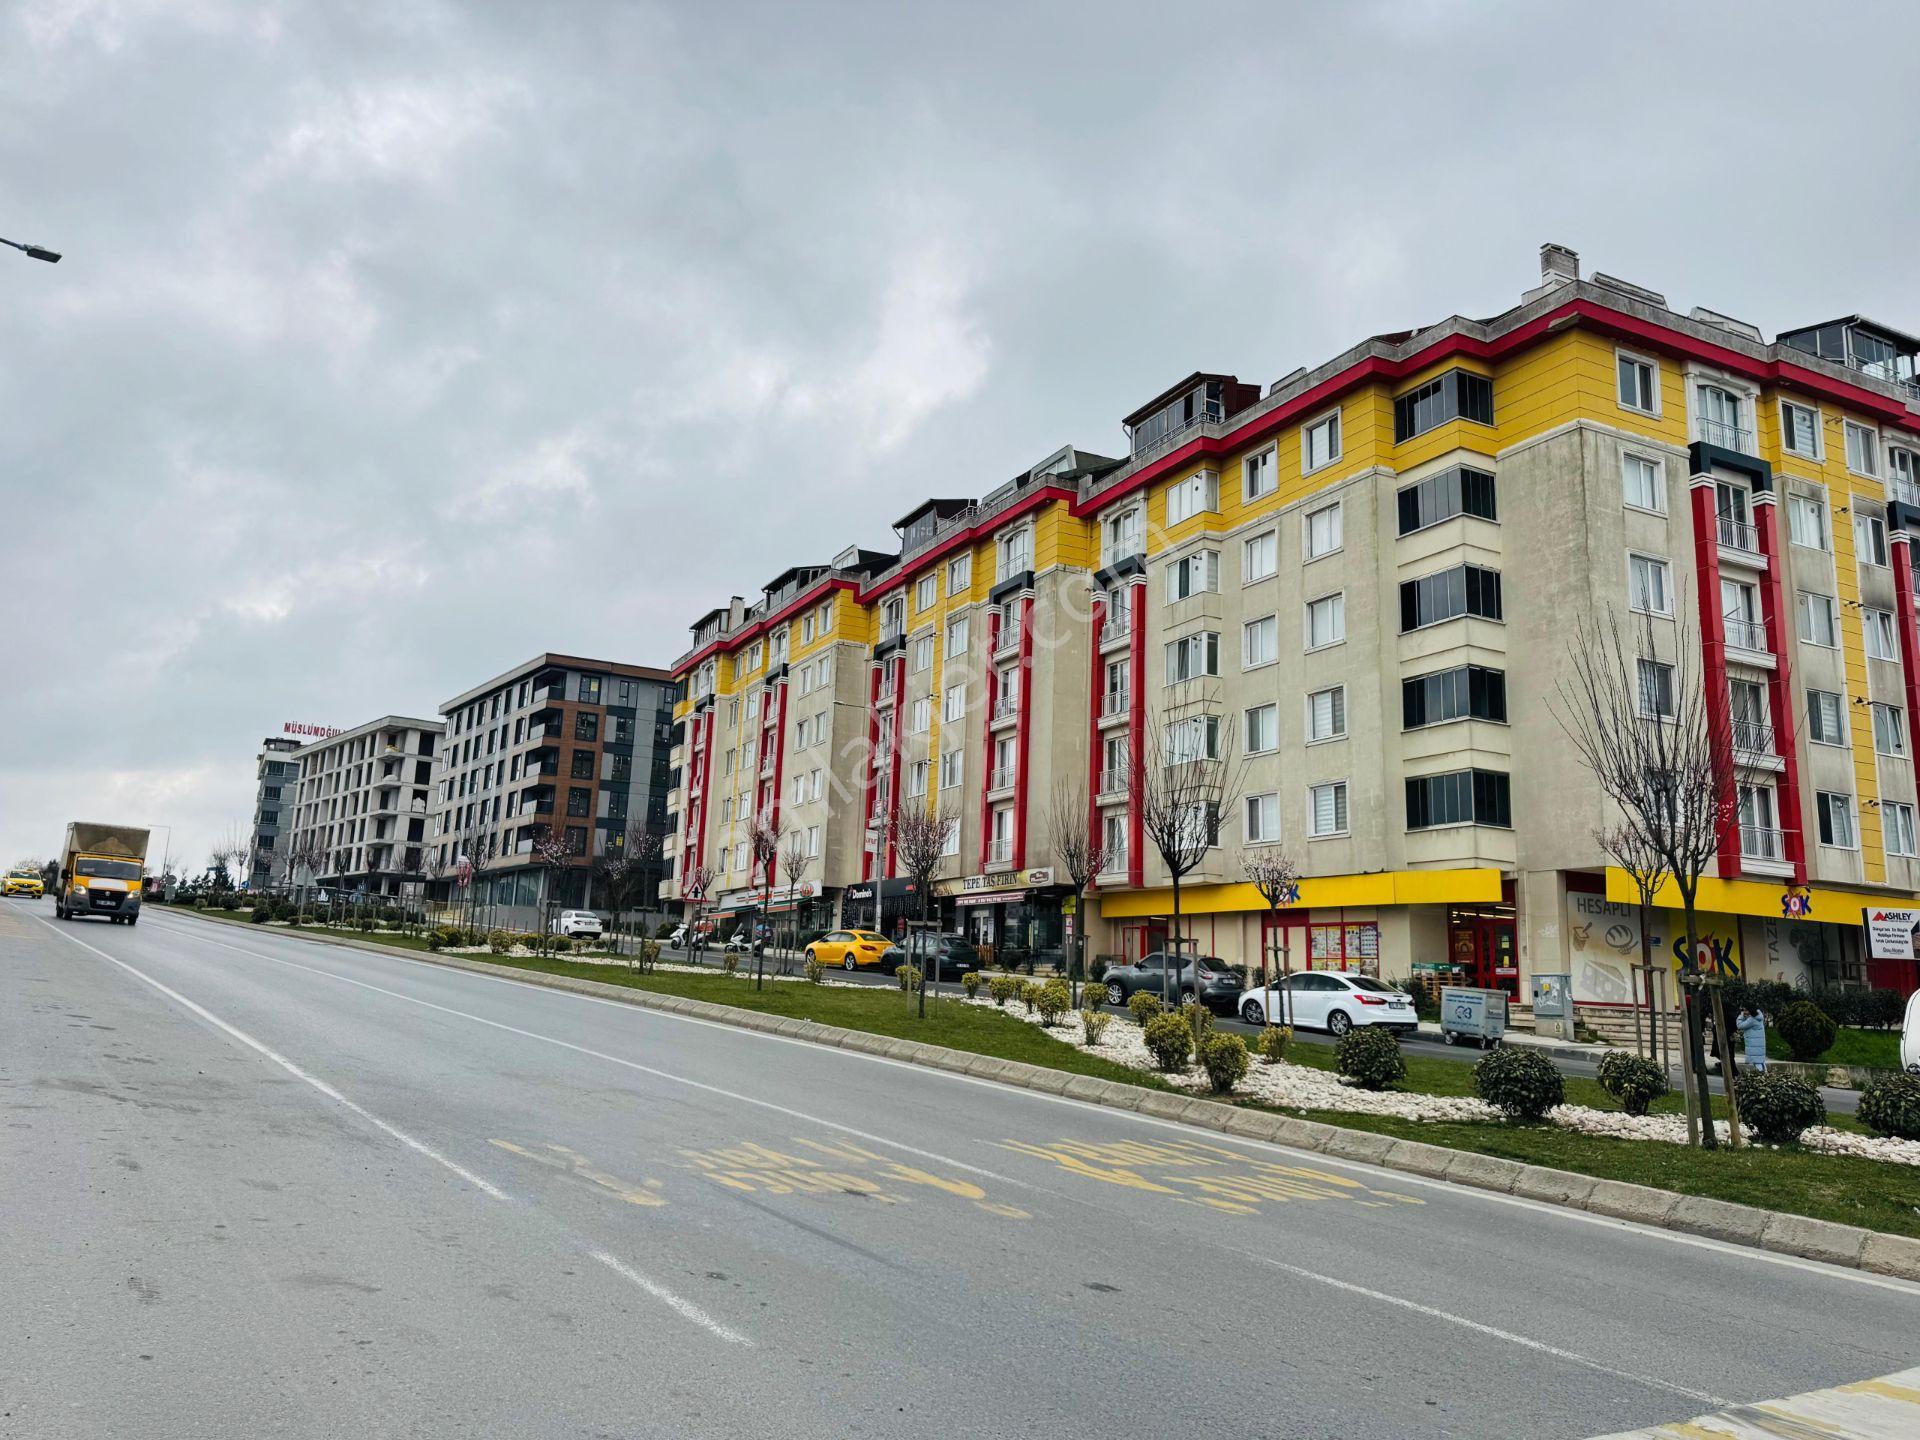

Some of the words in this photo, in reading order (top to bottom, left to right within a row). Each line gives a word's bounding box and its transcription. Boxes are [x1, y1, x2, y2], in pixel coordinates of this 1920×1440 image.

[963, 878, 980, 889] TEPE
[997, 873, 1018, 886] FIRIN
[852, 888, 873, 899] Domino's
[1883, 912, 1912, 921] ASHLEY
